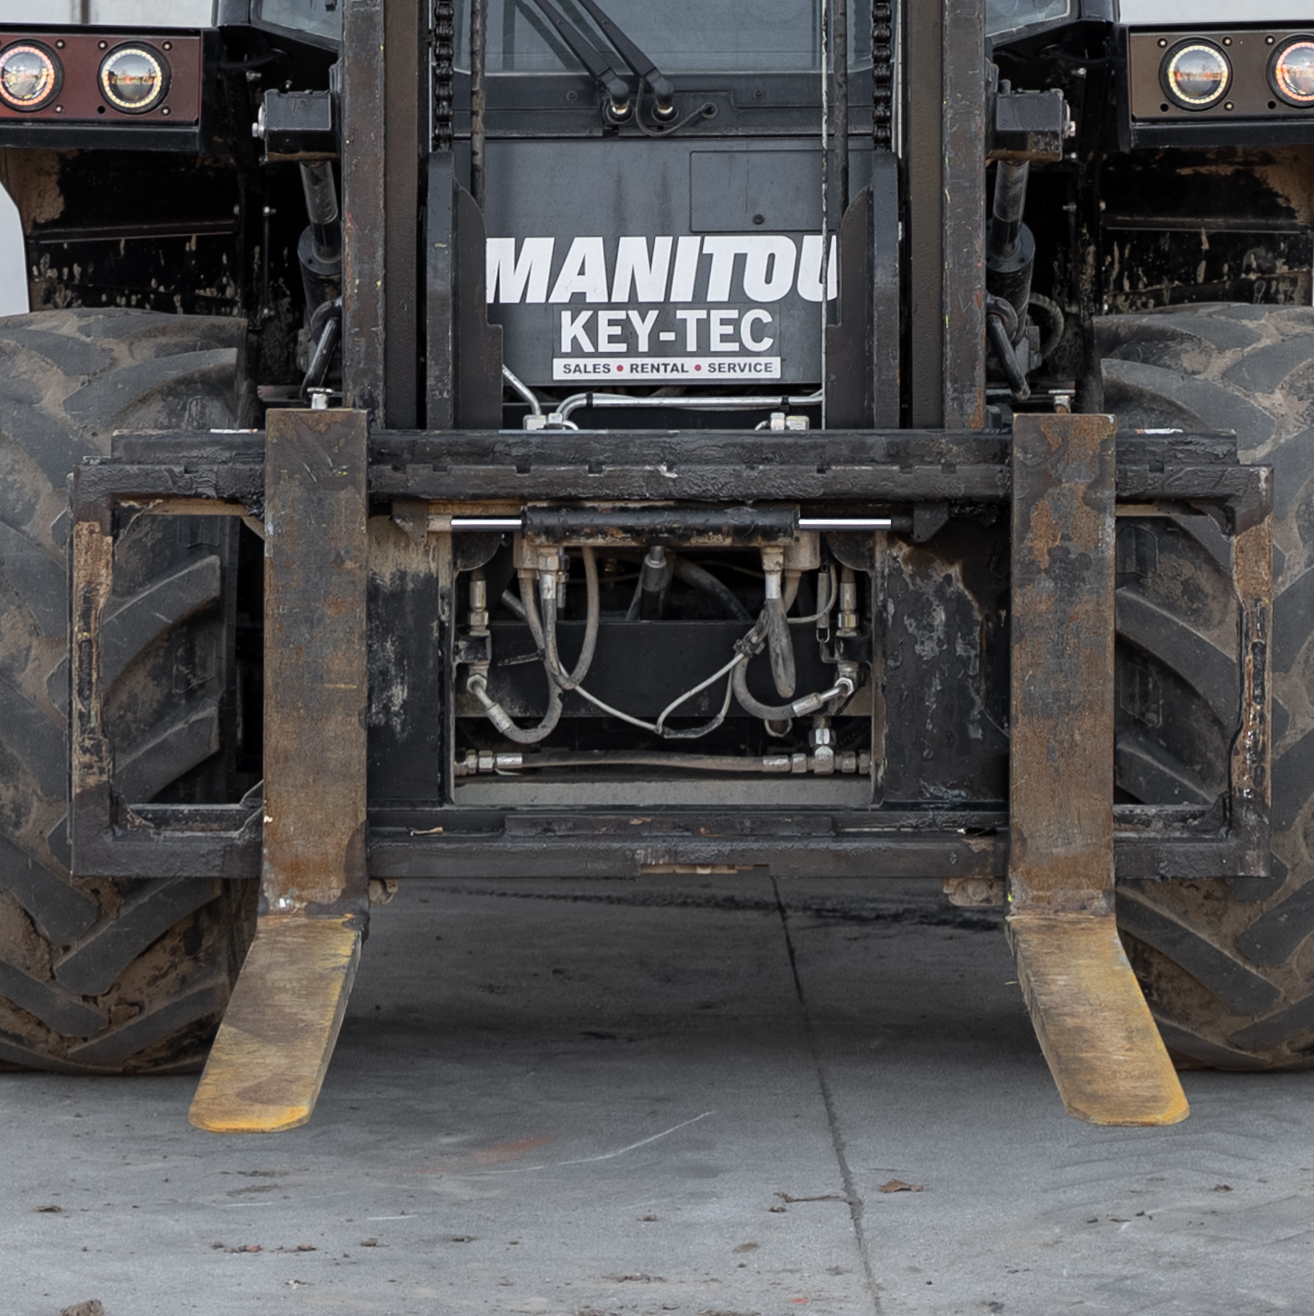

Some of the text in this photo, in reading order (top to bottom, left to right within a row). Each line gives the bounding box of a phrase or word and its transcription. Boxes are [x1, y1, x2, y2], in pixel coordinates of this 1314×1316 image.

[485, 234, 838, 303] MANITOU
[560, 308, 774, 353] KEY-TEC
[563, 361, 774, 374] SALES RENTAL SERVICE
